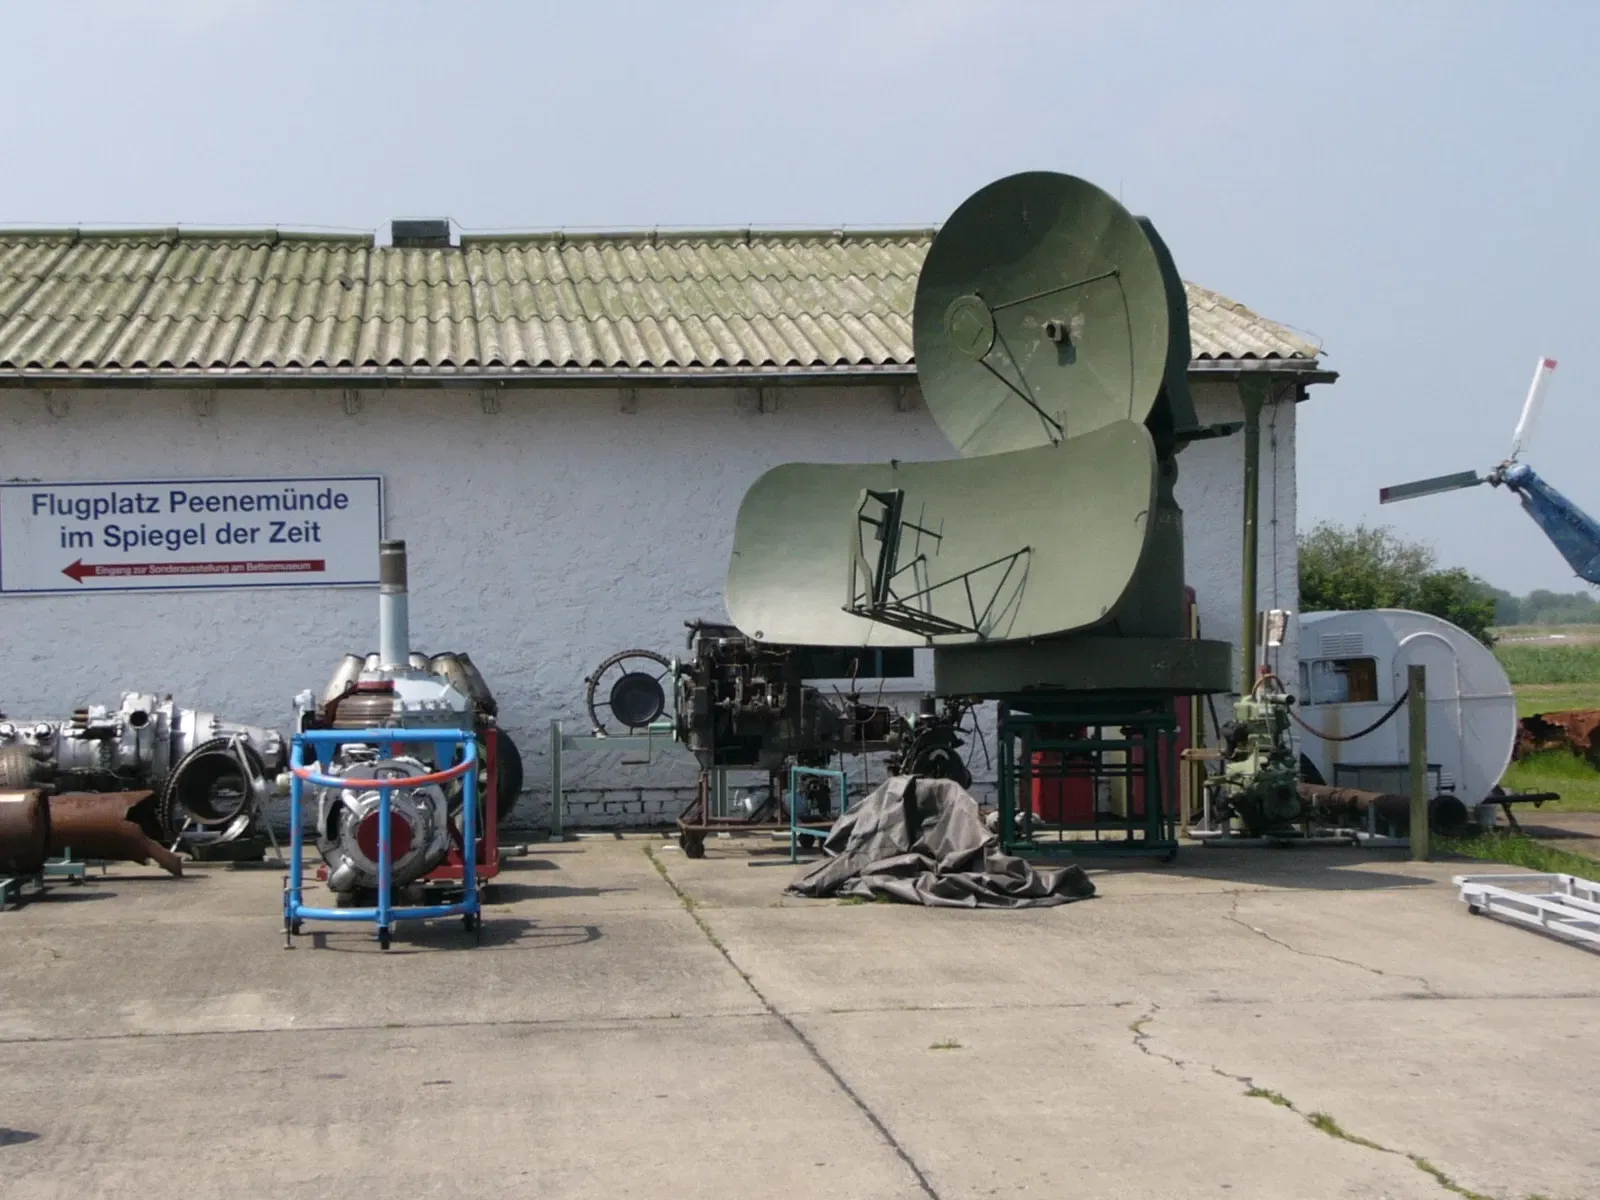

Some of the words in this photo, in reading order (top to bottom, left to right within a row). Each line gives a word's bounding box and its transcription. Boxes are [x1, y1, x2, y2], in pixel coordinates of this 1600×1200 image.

[31, 491, 160, 520] Flugplatz
[170, 488, 348, 513] Peenemünde
[61, 526, 93, 548] im
[103, 523, 205, 552] Spiegel
[216, 522, 260, 544] der
[269, 521, 321, 543] Zeit
[95, 565, 131, 576] Eingang
[133, 566, 148, 575] zur
[231, 564, 245, 572] am
